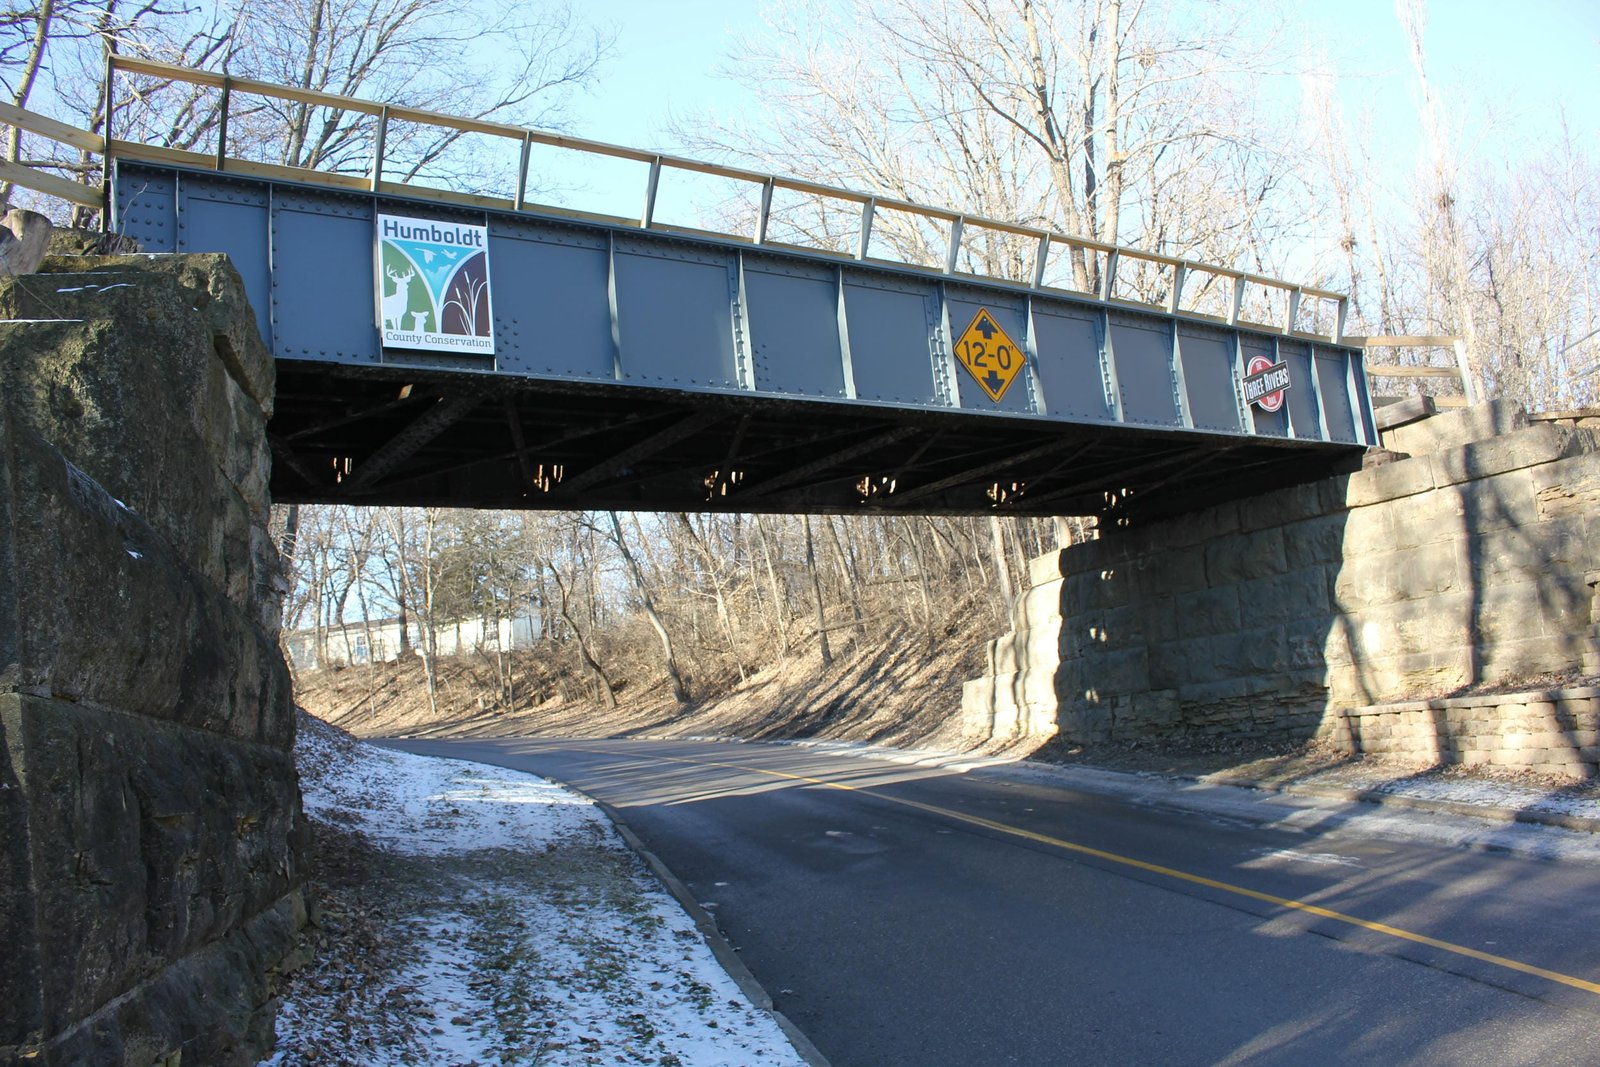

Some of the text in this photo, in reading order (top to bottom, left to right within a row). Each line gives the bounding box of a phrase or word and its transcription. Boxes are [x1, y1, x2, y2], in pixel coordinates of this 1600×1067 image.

[384, 219, 482, 247] Humboldt
[386, 331, 492, 348] County Conservation
